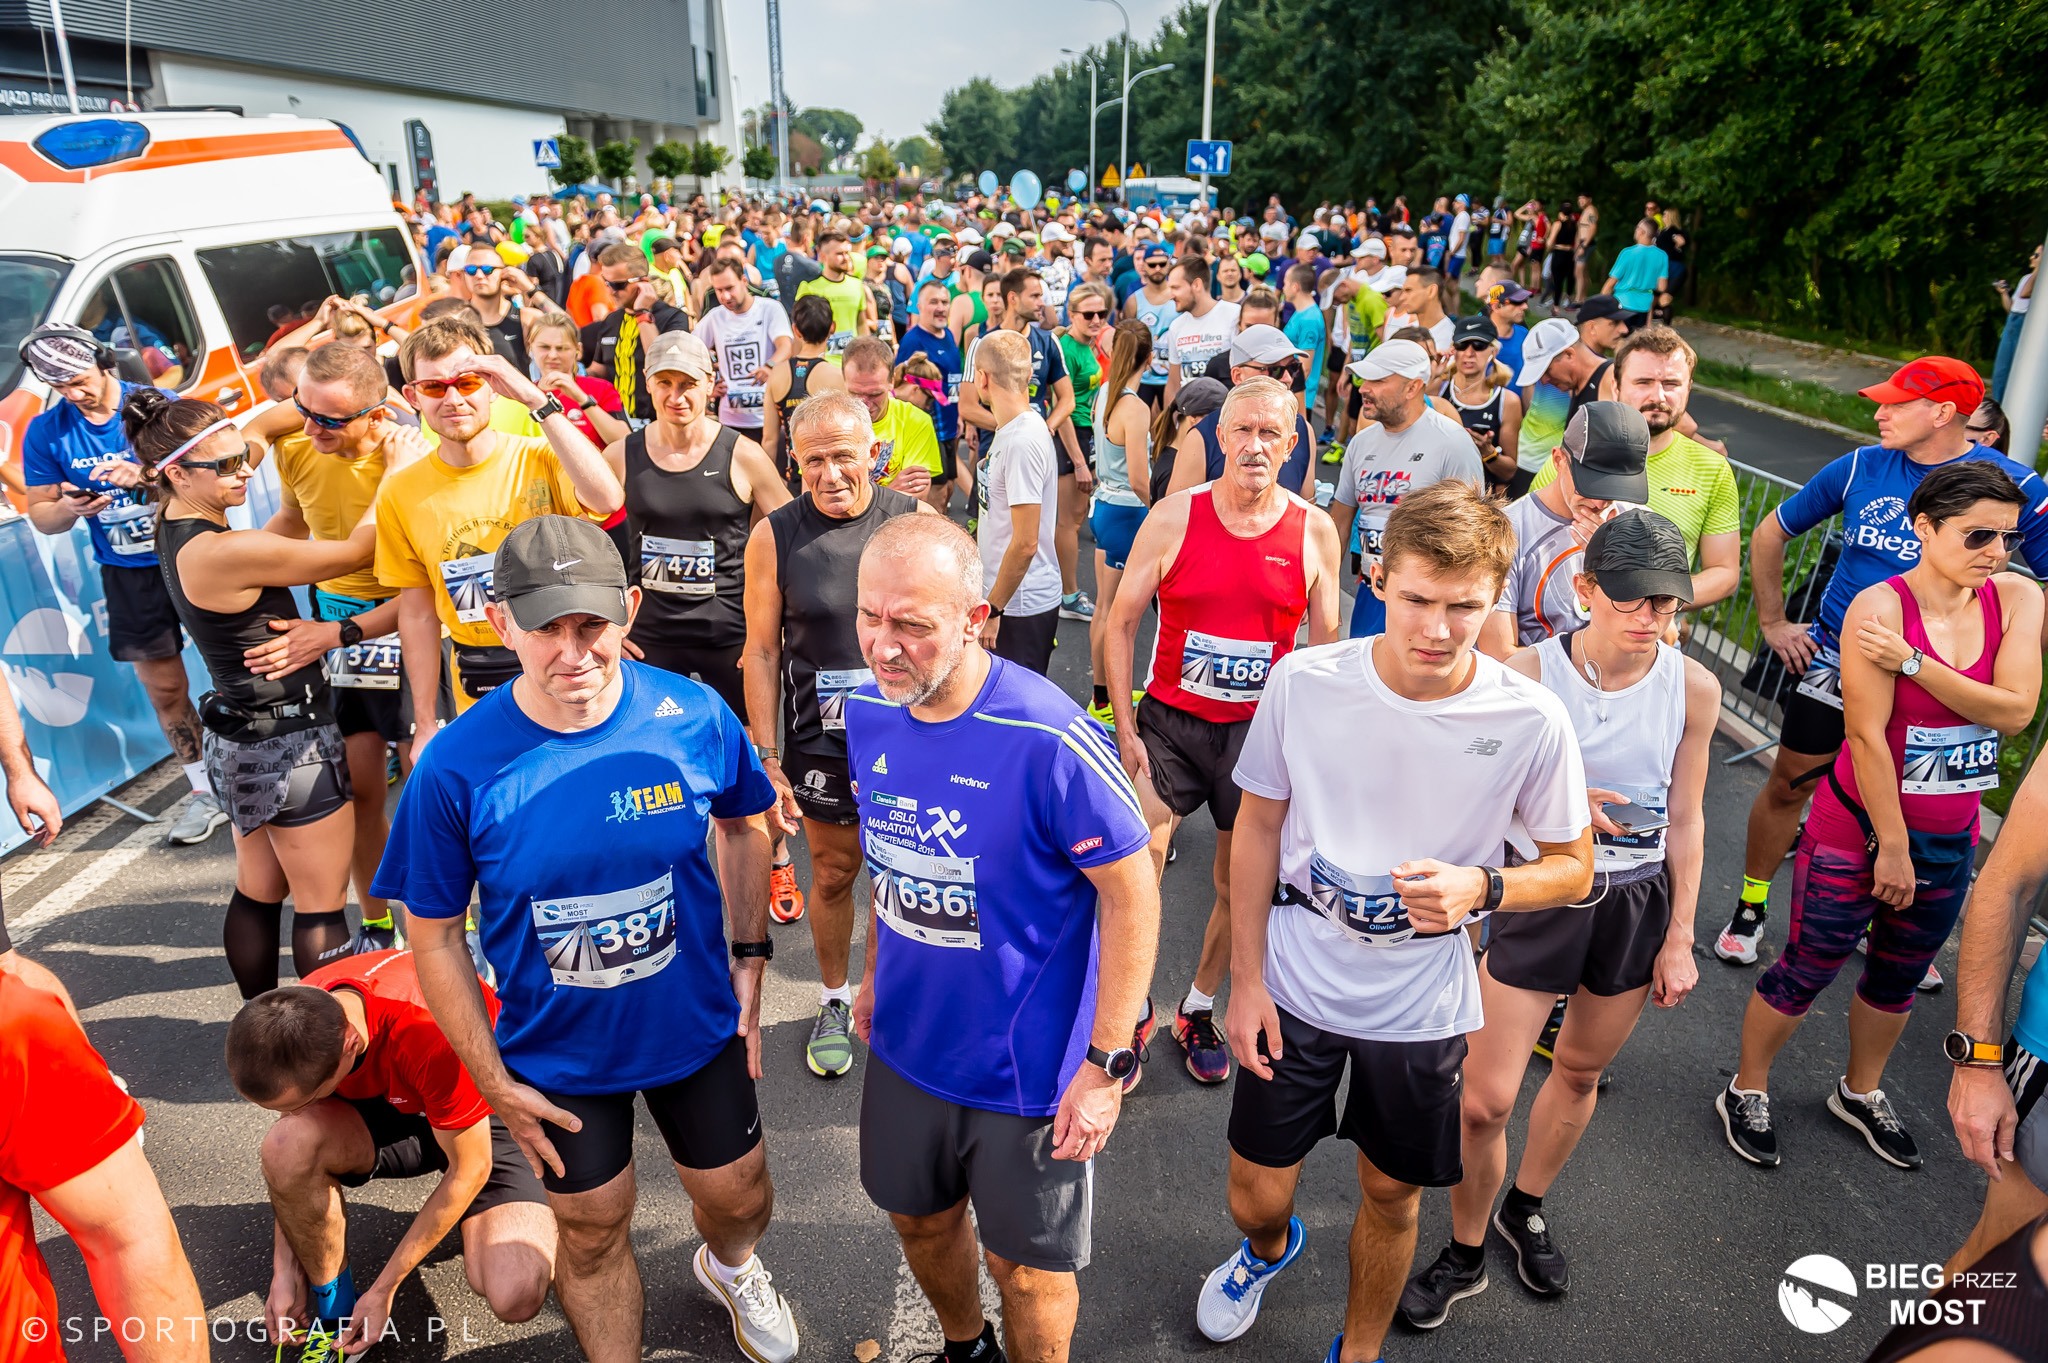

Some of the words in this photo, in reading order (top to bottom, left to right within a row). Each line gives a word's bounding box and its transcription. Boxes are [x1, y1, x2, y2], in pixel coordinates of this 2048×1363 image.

[31, 91, 73, 109] PARKIN
[126, 515, 157, 537] 13
[1857, 524, 1922, 561] Bieg
[667, 555, 711, 577] 478
[347, 644, 395, 668] 371
[1215, 656, 1266, 682] 168
[655, 707, 684, 718] adidas
[1947, 740, 1994, 770] 418
[950, 774, 990, 790] Kredinor
[631, 781, 684, 812] TEAM
[876, 795, 897, 806] Danske
[899, 800, 916, 809] Bank
[867, 816, 916, 837] MARATON
[889, 810, 917, 824] OSLO
[876, 832, 917, 849] SEPTEMBER
[918, 844, 936, 857] 2015
[1074, 839, 1100, 853] MENY
[930, 862, 962, 876] 10km
[898, 876, 968, 917] 636
[561, 902, 579, 911] BIEG
[567, 909, 588, 917] MOST
[597, 900, 668, 954] 387
[1369, 923, 1397, 931] Oliwier
[632, 944, 650, 955] Olaf
